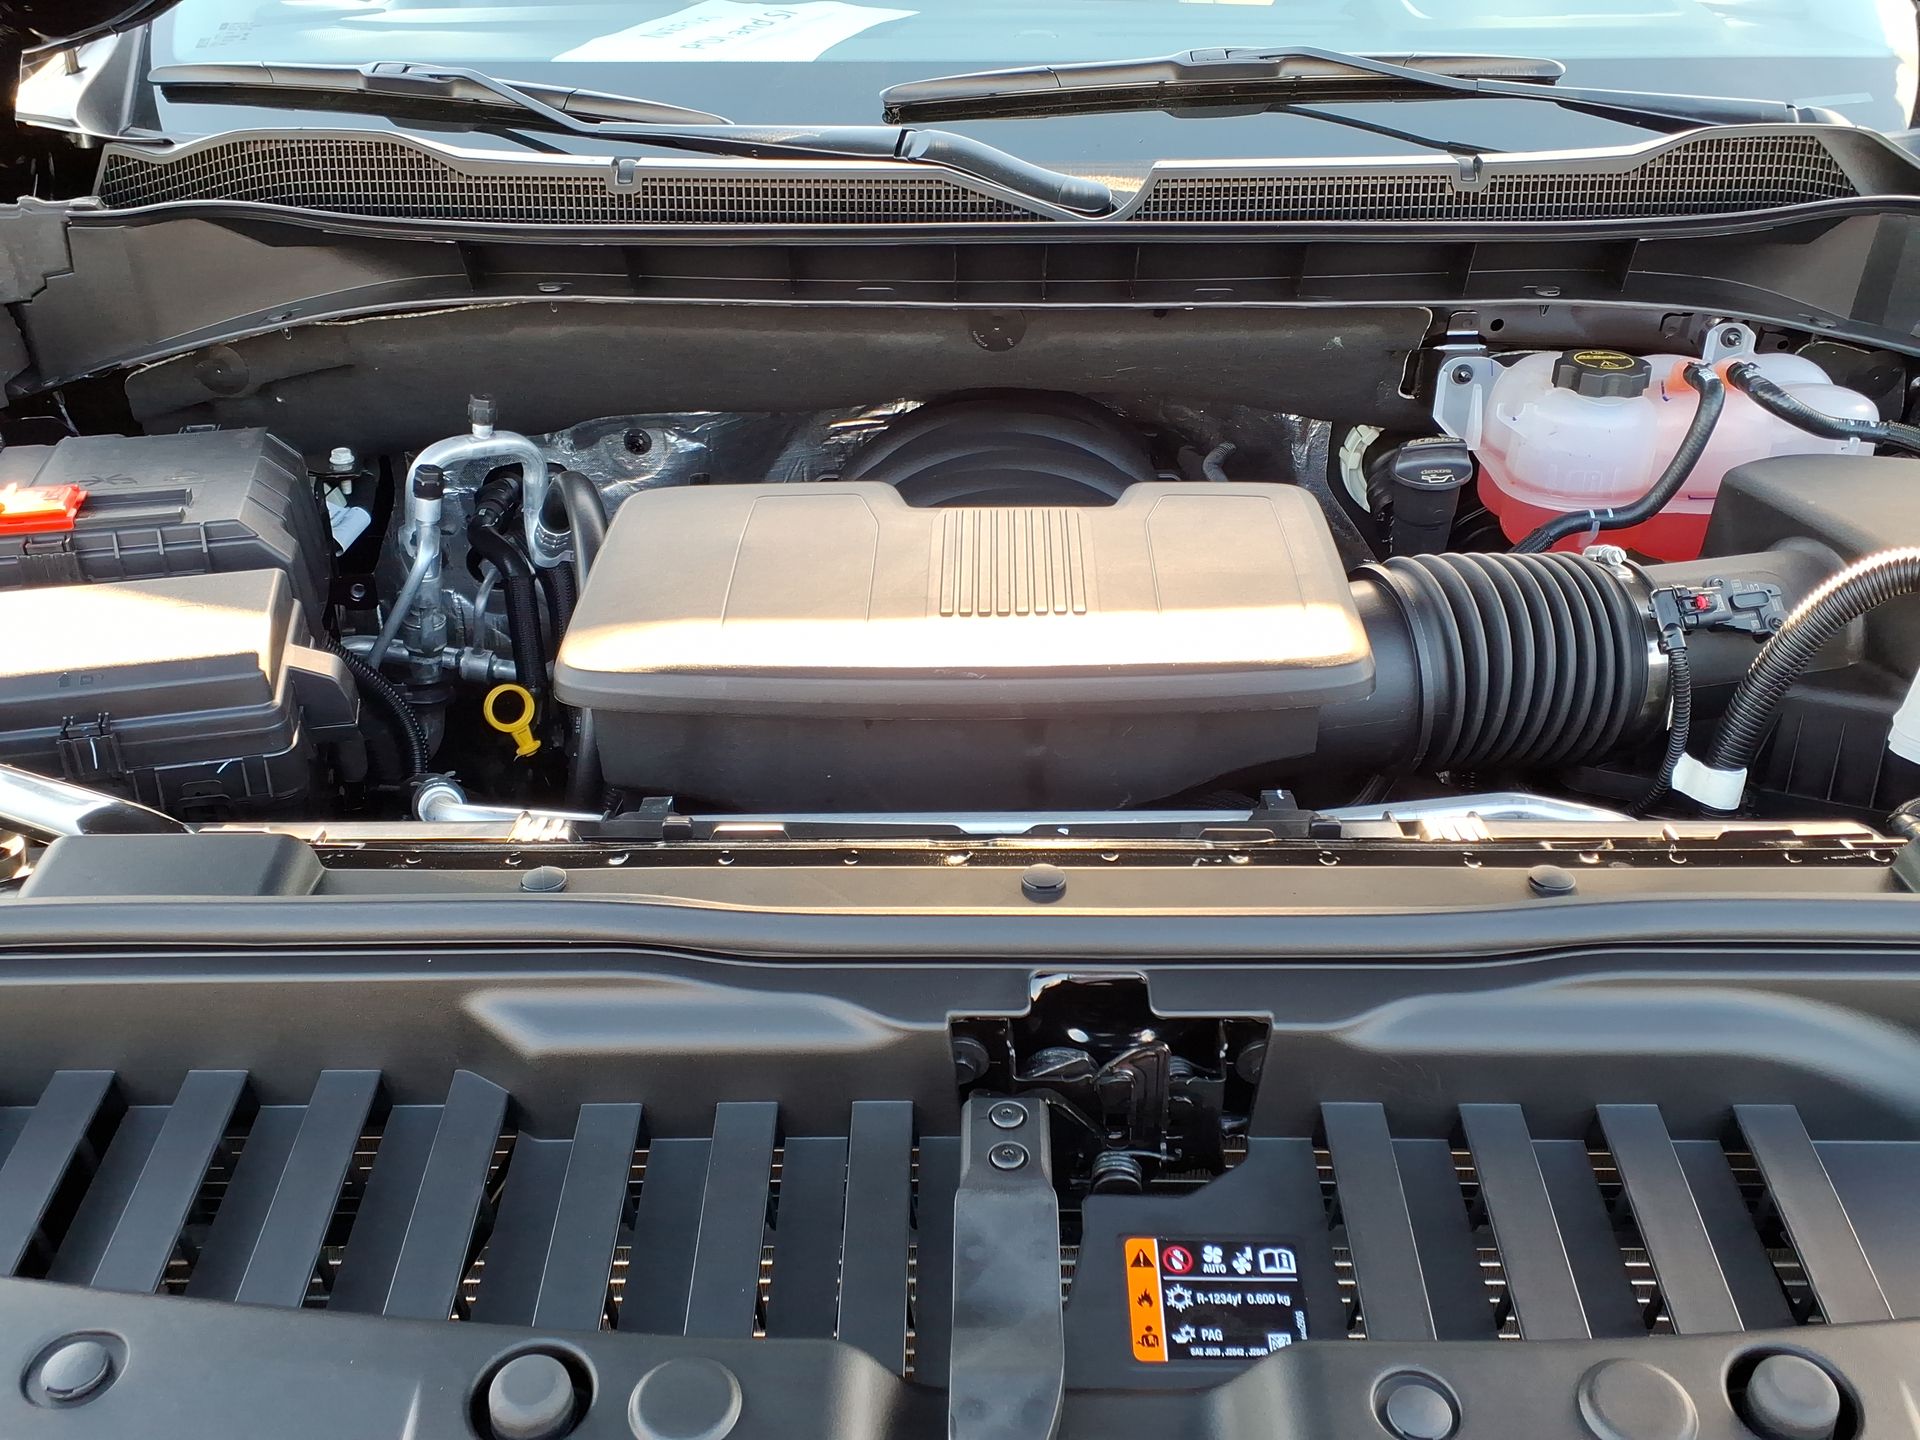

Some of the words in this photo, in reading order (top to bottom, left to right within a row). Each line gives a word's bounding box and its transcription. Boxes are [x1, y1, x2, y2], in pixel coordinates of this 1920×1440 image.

[1203, 1265, 1227, 1274] AUTO
[1197, 1293, 1242, 1307] R-1234yf
[1247, 1294, 1275, 1305] 0.600
[1277, 1294, 1291, 1307] kg
[1202, 1329, 1223, 1342] PAG
